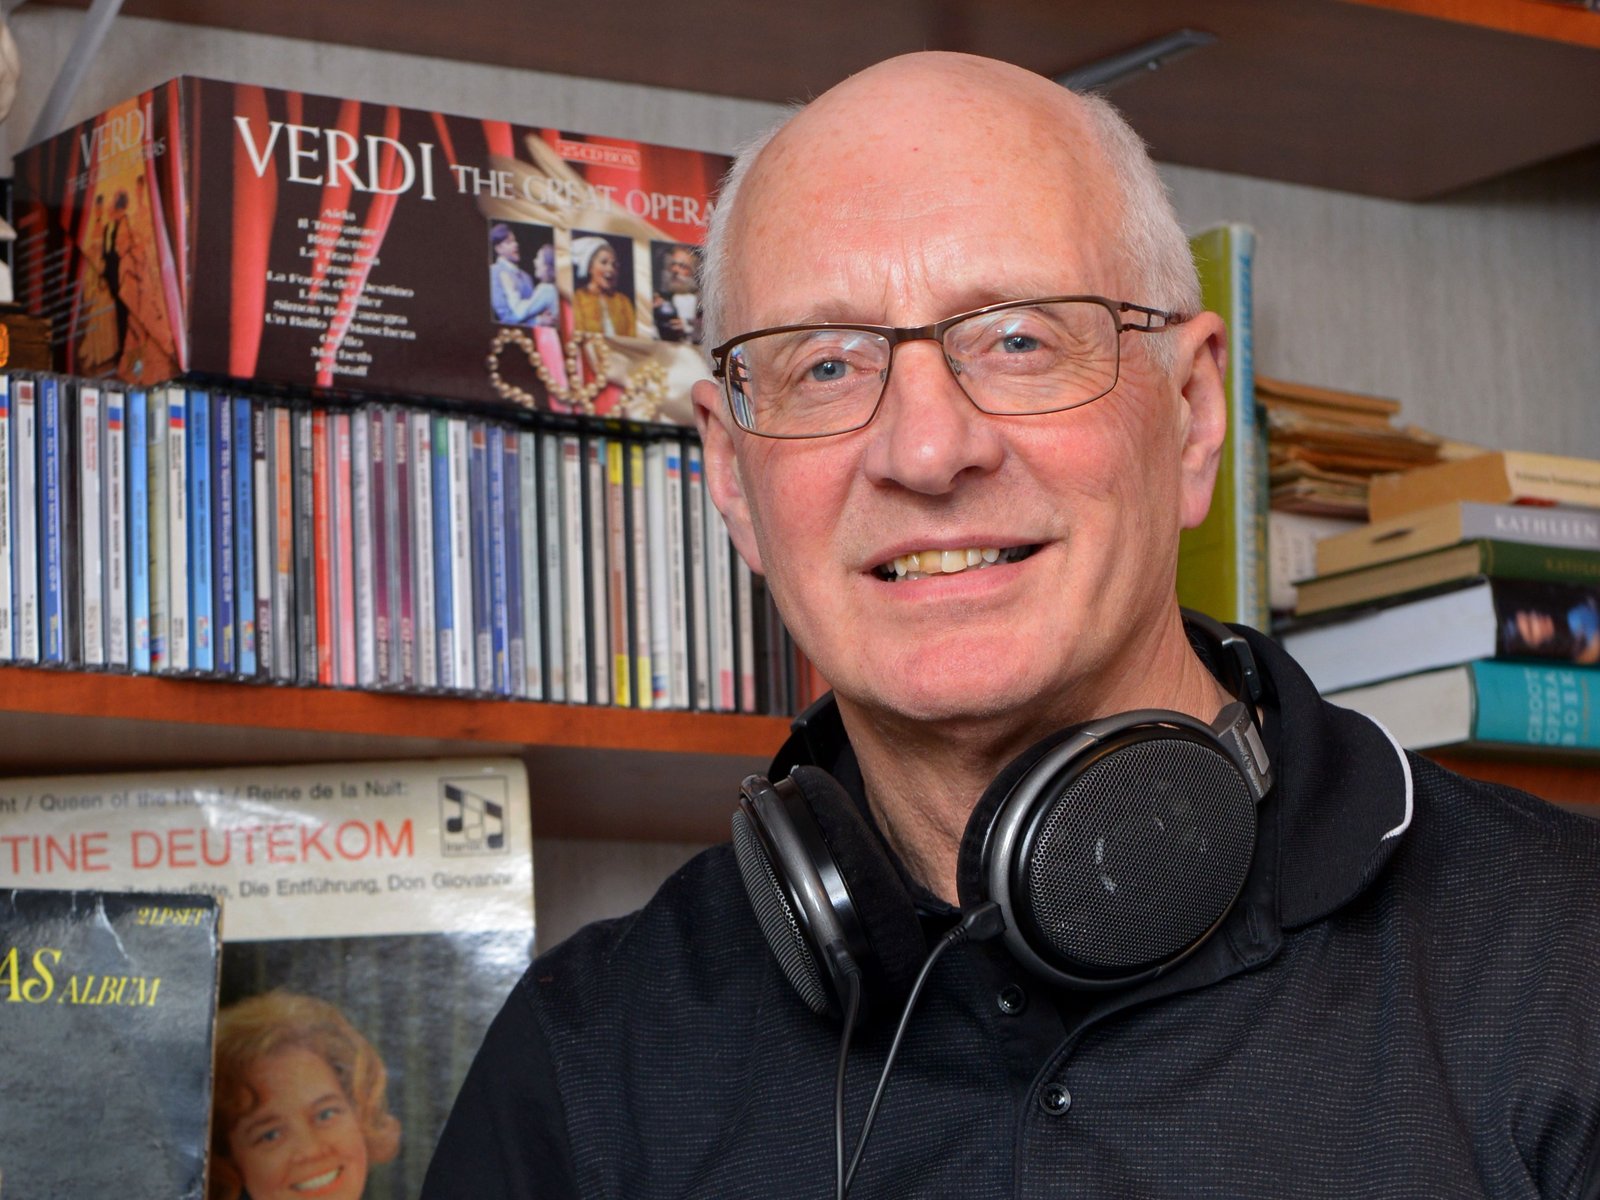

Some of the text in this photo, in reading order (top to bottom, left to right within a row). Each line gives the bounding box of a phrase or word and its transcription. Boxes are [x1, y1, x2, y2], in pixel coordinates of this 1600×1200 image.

[81, 101, 153, 168] VERDI
[233, 116, 436, 200] VERDI
[449, 164, 516, 199] THE
[522, 175, 619, 212] GREAT
[322, 209, 356, 221] Aida
[312, 221, 380, 237] Trovatore
[307, 234, 373, 250] Rigoletto
[299, 248, 381, 266] La Traviata
[266, 271, 286, 282] La
[289, 274, 330, 287] Forza
[299, 290, 340, 302] Luisa
[273, 301, 321, 315] Simon
[265, 314, 287, 325] Un
[289, 317, 328, 329] Ballo
[1494, 513, 1599, 540] KATHLEEN
[40, 792, 104, 813] Queen
[111, 790, 129, 808] of
[138, 789, 166, 807] the
[246, 784, 303, 801] Reine
[309, 782, 335, 800] de
[341, 781, 358, 798] la
[1, 817, 415, 876] TINE DEUTEKOM
[239, 879, 270, 898] Die
[388, 873, 426, 891] Don
[58, 975, 161, 1008] ALBUM
